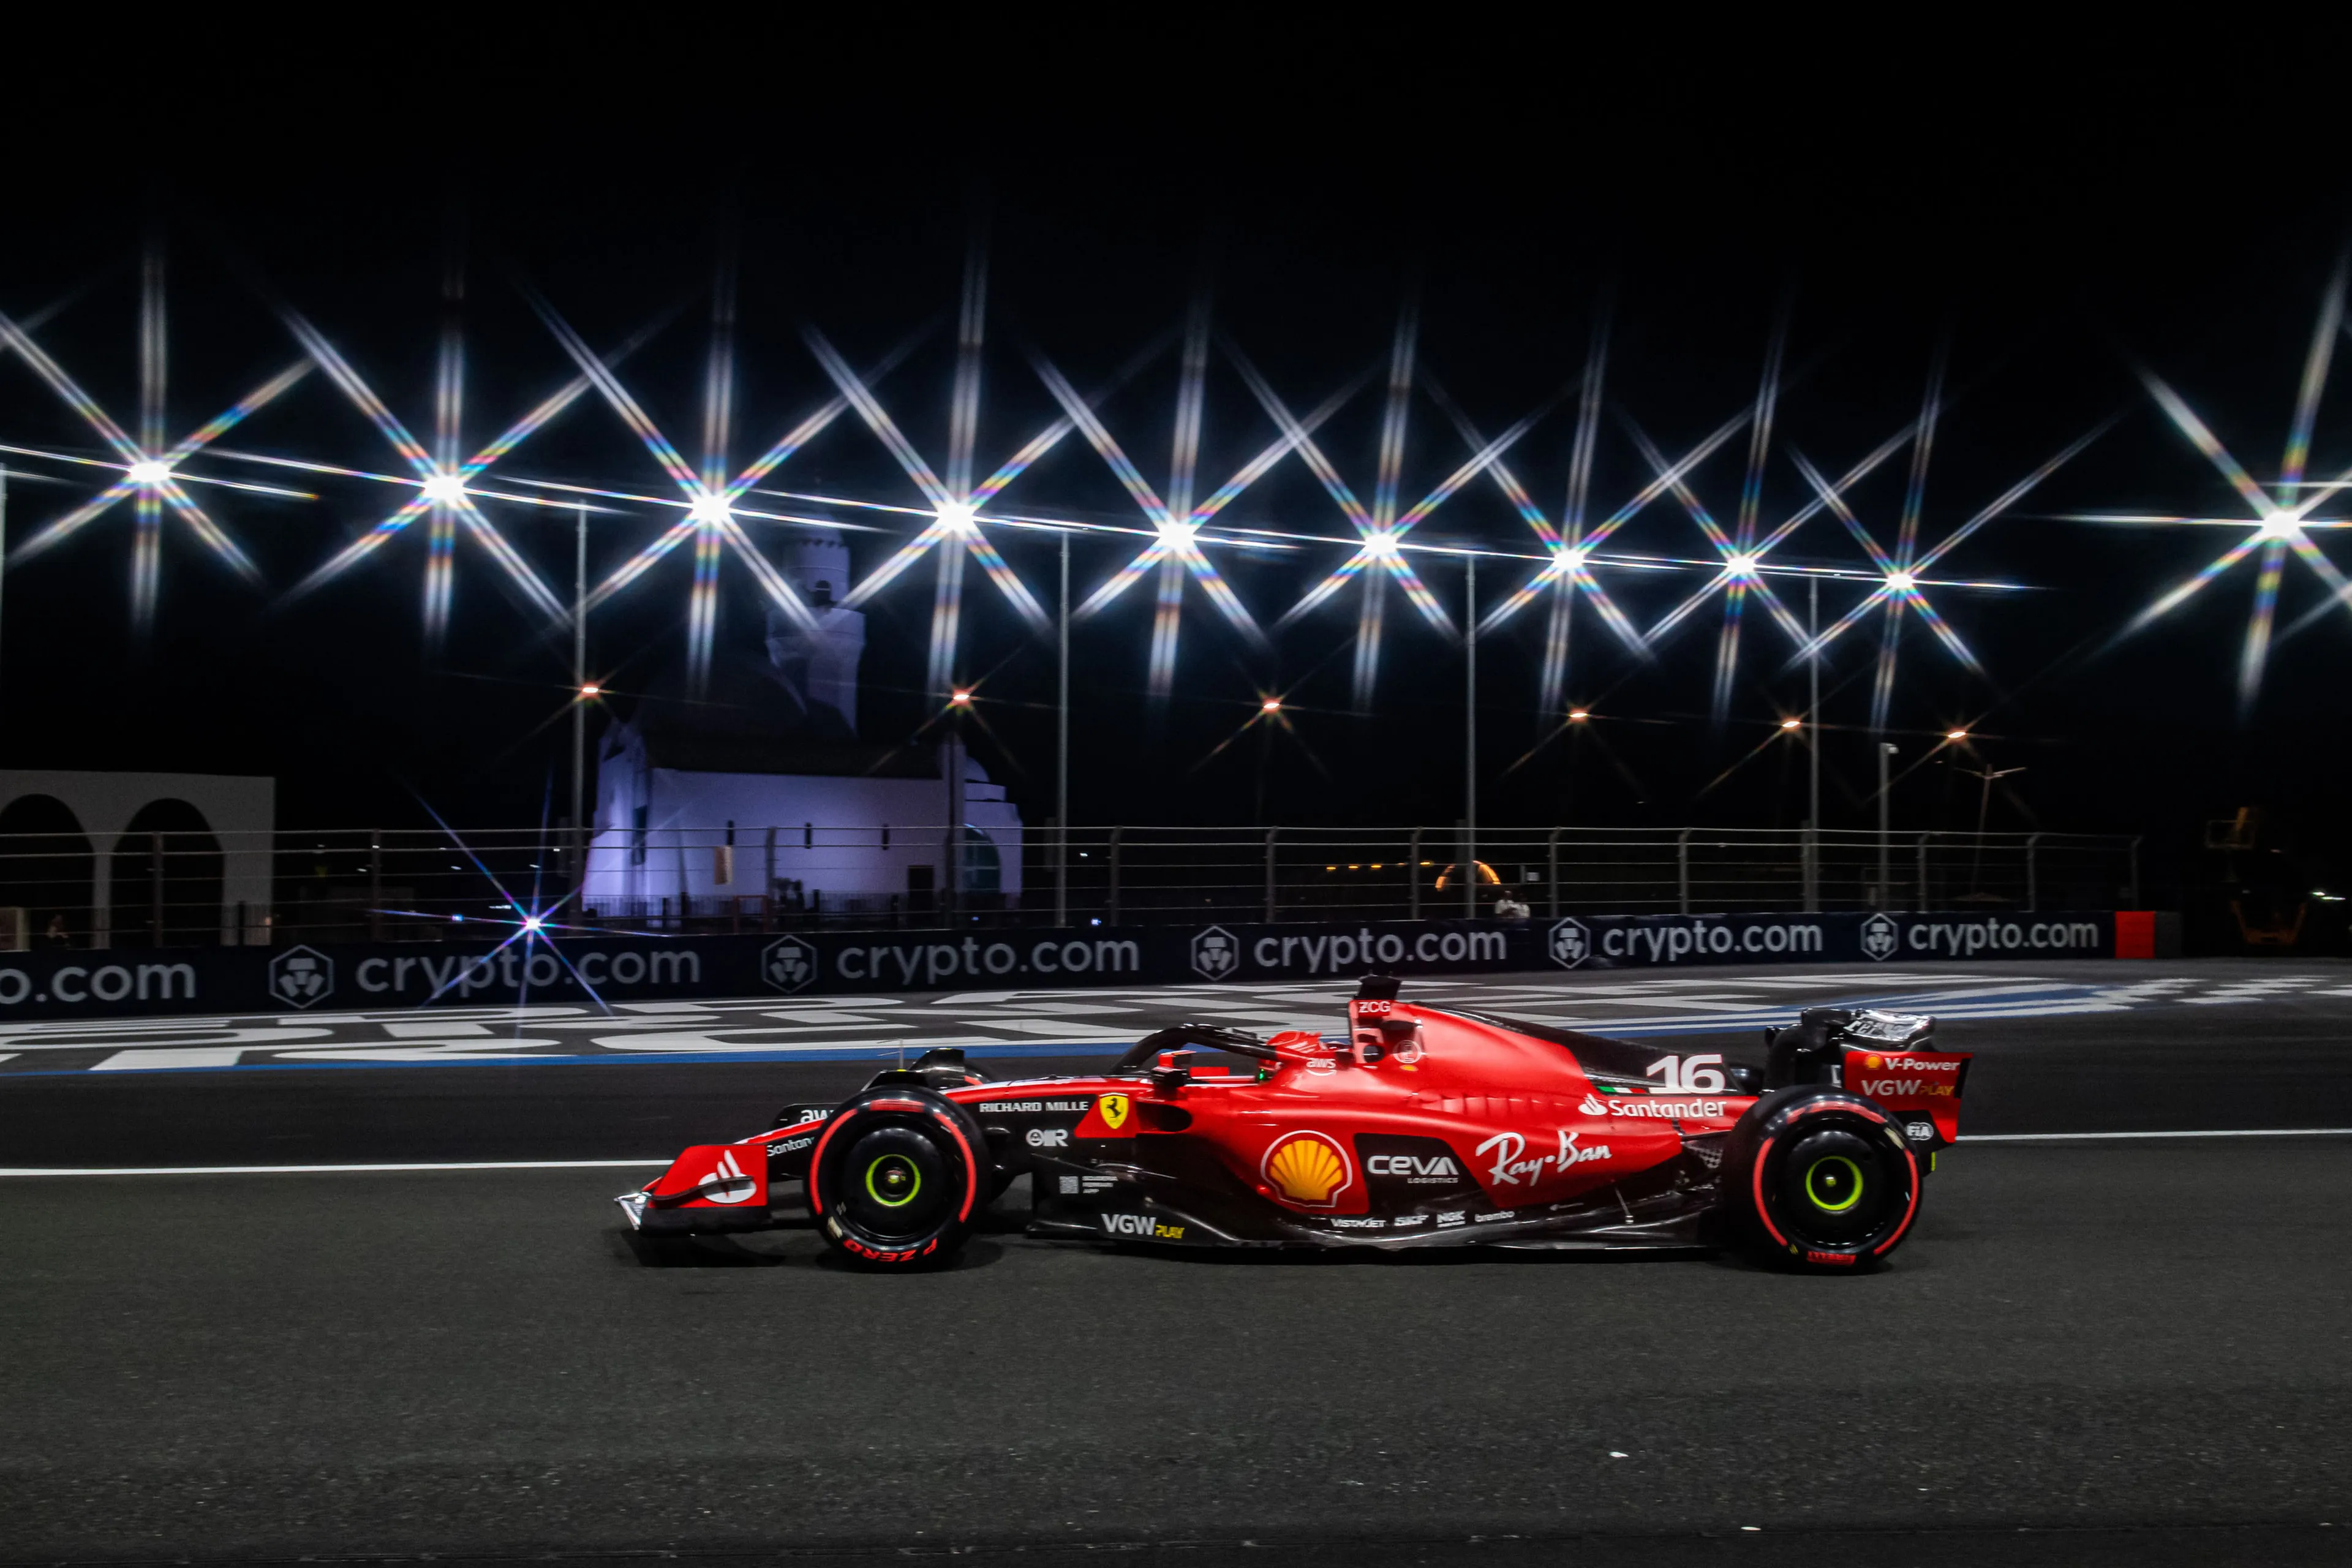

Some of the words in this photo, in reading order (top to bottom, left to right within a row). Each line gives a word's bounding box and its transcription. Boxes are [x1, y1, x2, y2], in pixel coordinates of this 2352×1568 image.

[1602, 920, 1823, 962] crypto.com
[1909, 918, 2098, 955] crypto.com
[837, 937, 1140, 985] crypto.com
[1254, 928, 1507, 973] crypto.com
[356, 947, 700, 998] crypto.com
[1359, 1001, 1391, 1012] ZCG
[1646, 1054, 1726, 1094] 16
[1885, 1058, 1960, 1071] V-Power
[1861, 1079, 1922, 1096] VGW
[800, 1109, 834, 1123] aw
[979, 1102, 1042, 1112] RICHARD
[1046, 1101, 1090, 1112] MILLE
[1608, 1098, 1727, 1118] Santander
[766, 1137, 815, 1157] Santan
[1101, 1213, 1157, 1236] VGW
